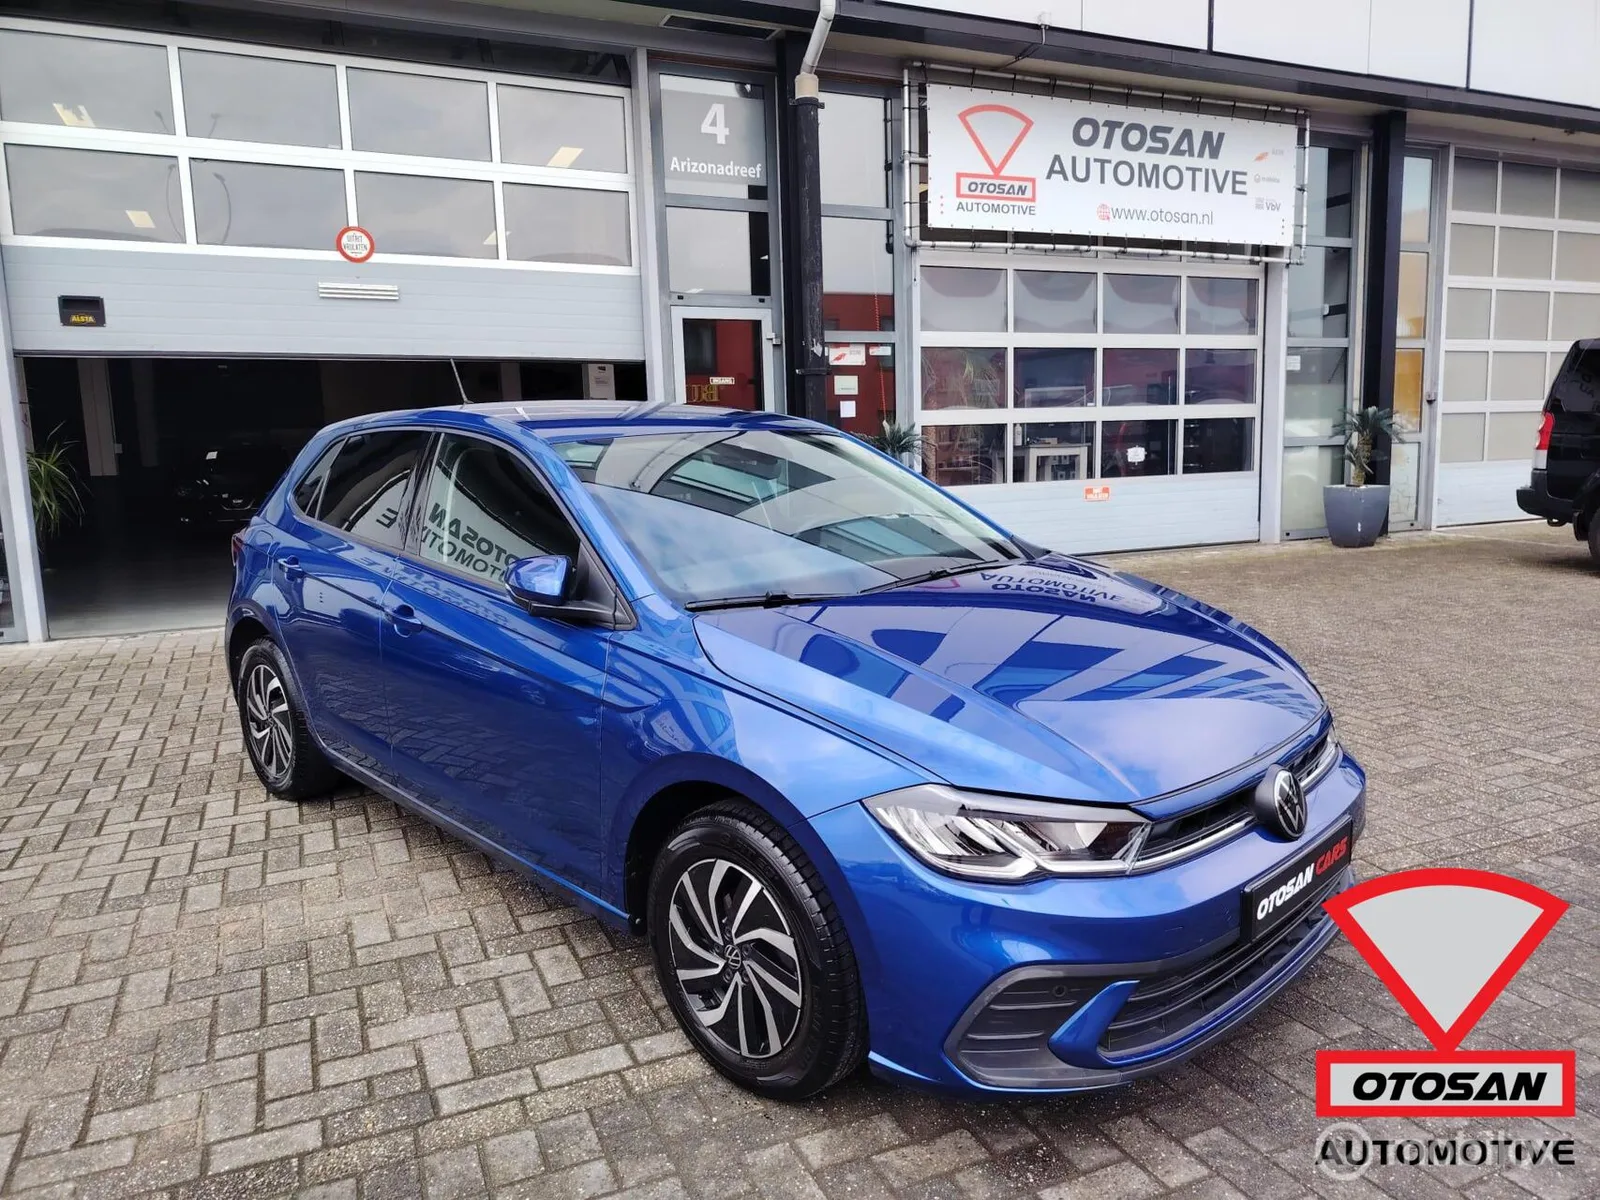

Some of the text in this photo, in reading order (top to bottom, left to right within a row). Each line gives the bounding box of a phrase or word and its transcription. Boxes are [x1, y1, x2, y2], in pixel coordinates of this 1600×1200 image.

[701, 103, 730, 145] 4
[1072, 117, 1225, 160] OTOSAN
[670, 156, 762, 178] Arizonadreef
[1045, 154, 1248, 196] AUTOMOTIVE
[967, 180, 1028, 196] OTOSAN
[956, 201, 1036, 216] AUTOMOTIVE
[1111, 207, 1213, 225] www.otosan.nl
[1257, 836, 1349, 920] OTOSAN CARS
